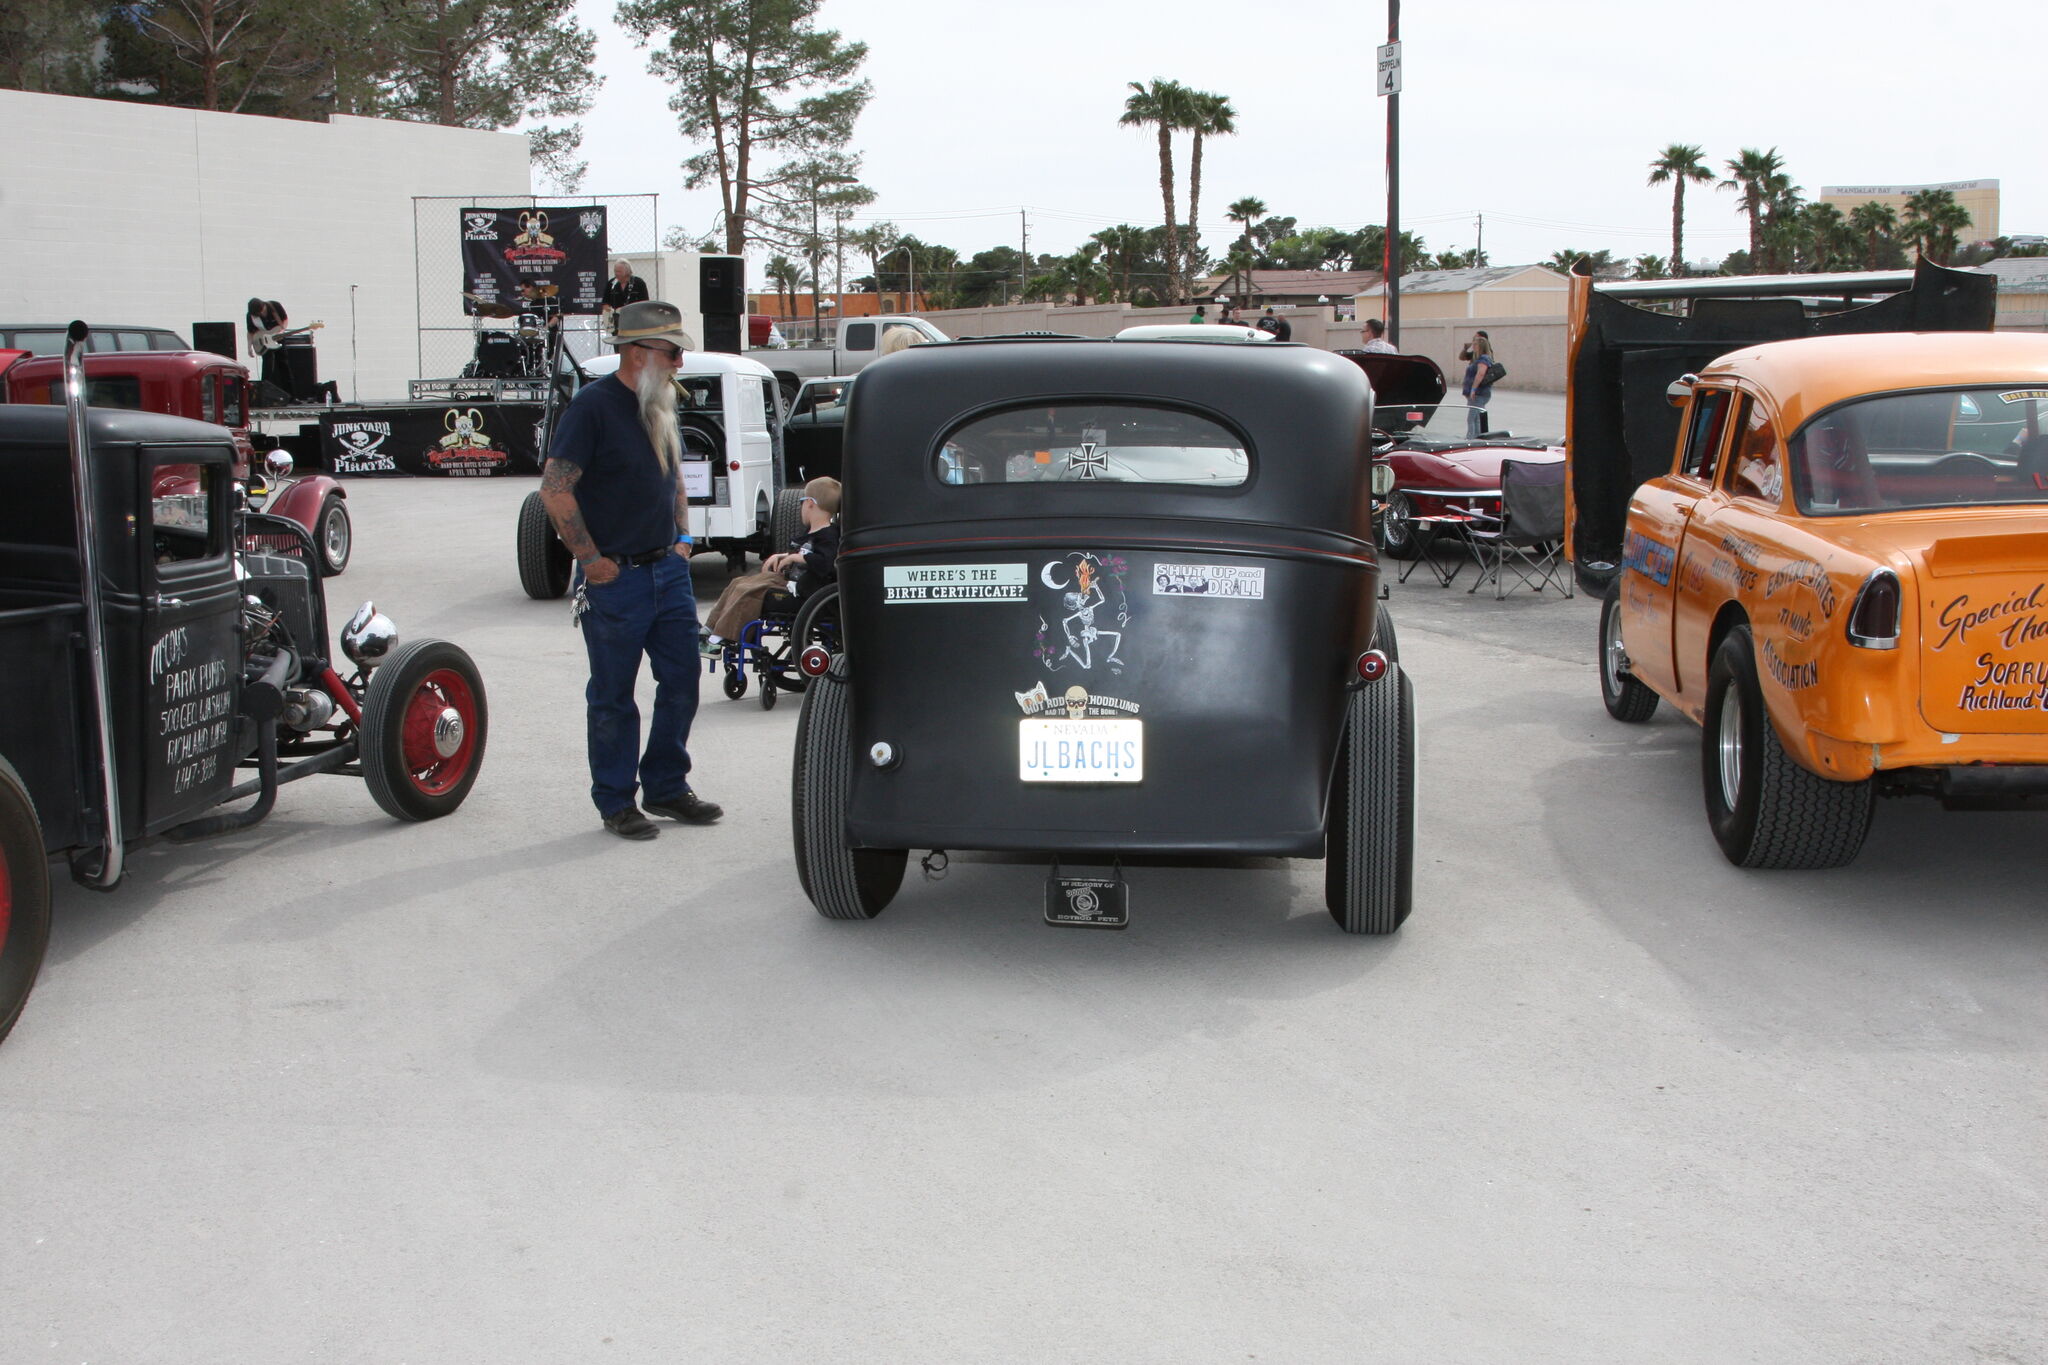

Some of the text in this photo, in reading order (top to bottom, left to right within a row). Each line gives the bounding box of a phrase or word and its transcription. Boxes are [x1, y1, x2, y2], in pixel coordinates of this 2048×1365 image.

[1385, 46, 1395, 58] LED
[1384, 70, 1394, 91] 4
[465, 212, 497, 221] JUNKYARD
[465, 230, 498, 240] PIRATES
[332, 422, 391, 438] JUNKYARD
[334, 456, 396, 473] PIRATES
[907, 569, 997, 582] WHERE'S THE
[1156, 564, 1262, 579] SHUT UP and
[887, 585, 1024, 599] BIRTH CERTIFICATE?
[1207, 579, 1262, 597] DRILL
[1931, 583, 2046, 652] Special
[1763, 637, 1819, 691] ASSOCIATION
[166, 659, 226, 703] PARK PUMPS
[1025, 697, 1065, 714] HOT ROD
[1057, 708, 1066, 716] TO
[1088, 694, 1140, 714] HOODLUMS
[1088, 707, 1100, 716] THE
[160, 707, 180, 736] 500
[1053, 725, 1108, 735] NEVADA
[1027, 741, 1135, 769] JLBACHS
